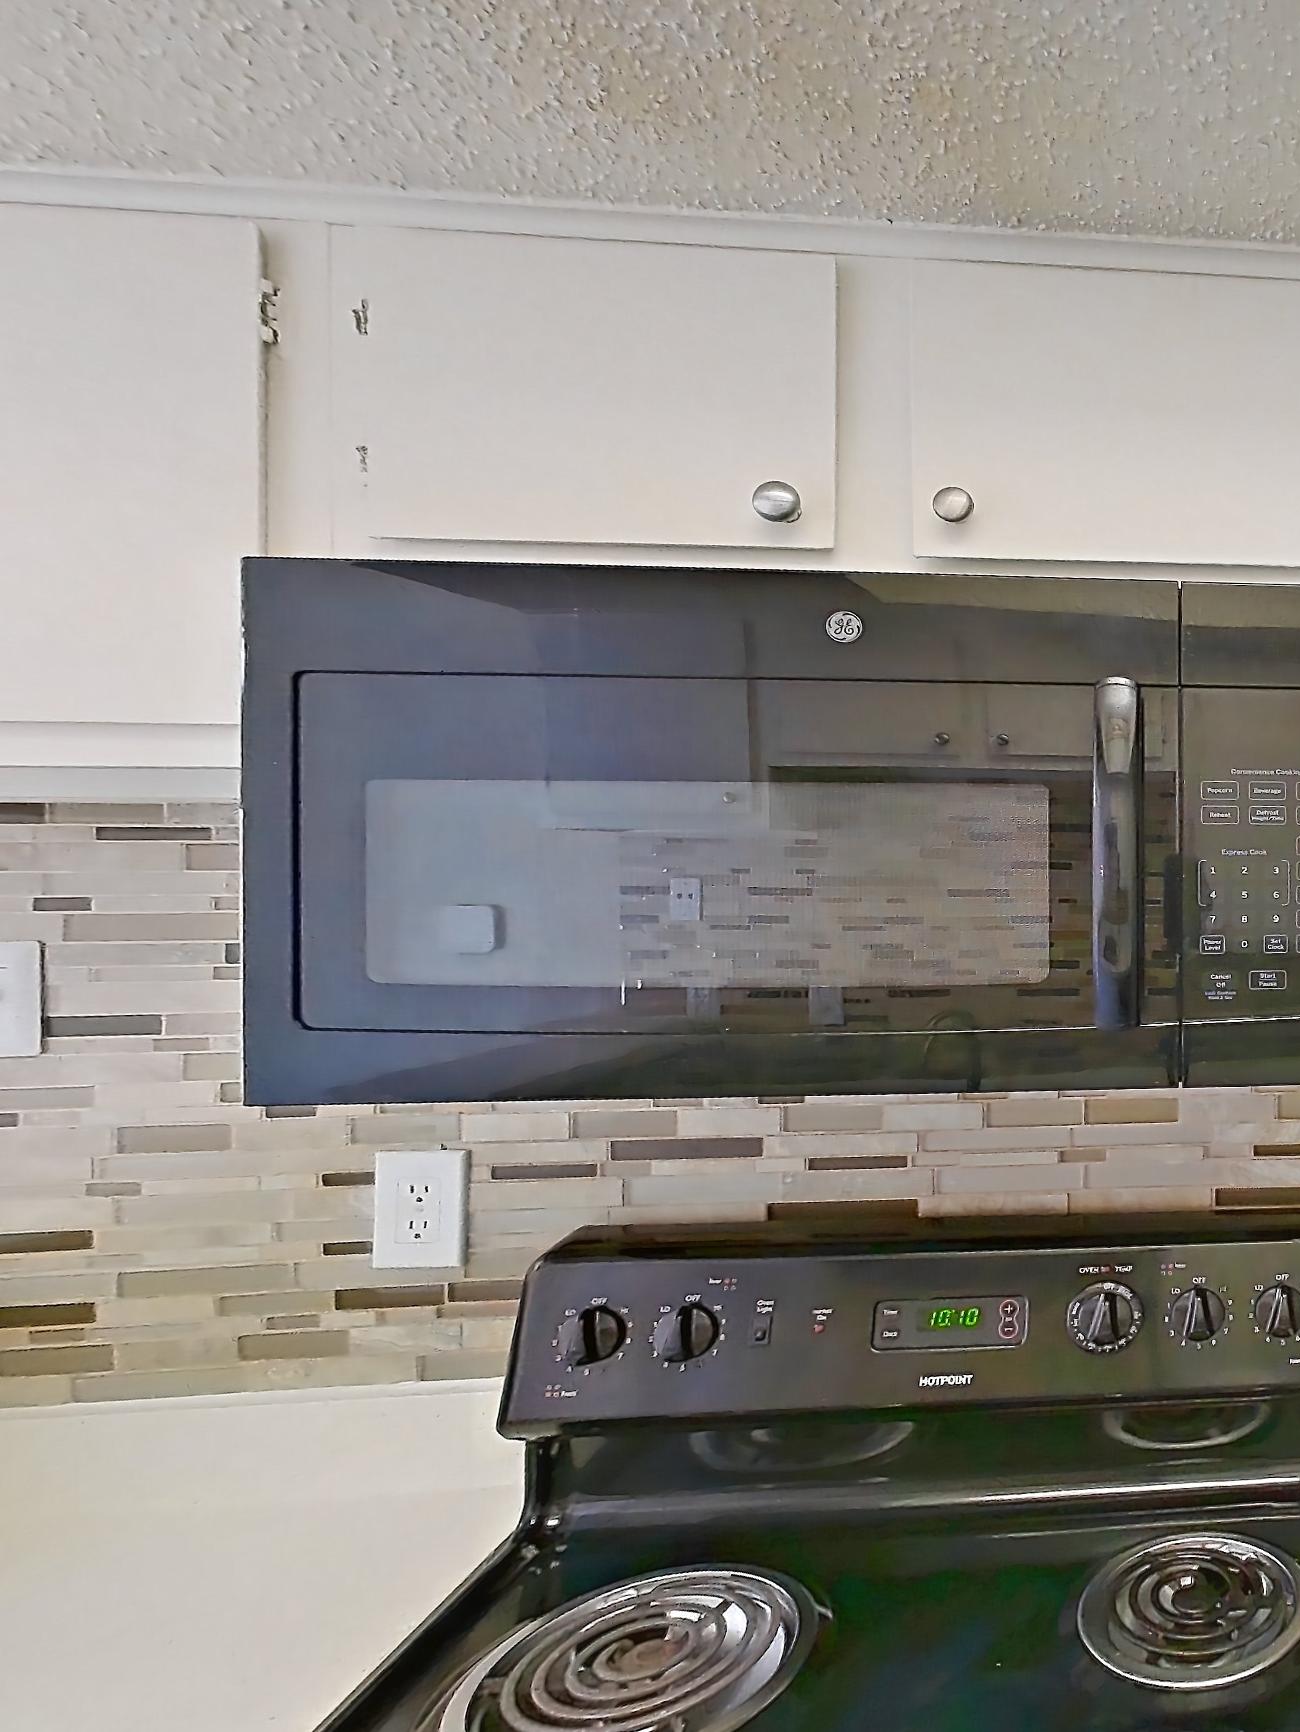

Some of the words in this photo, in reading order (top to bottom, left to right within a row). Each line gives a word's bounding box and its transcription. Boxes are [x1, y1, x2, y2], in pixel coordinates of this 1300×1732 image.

[1210, 866, 1216, 874] 1
[1241, 866, 1248, 874] 2
[1273, 866, 1279, 874] 3
[1210, 890, 1216, 898] 4
[1241, 890, 1248, 898] 5
[1273, 890, 1279, 898] 6
[1210, 915, 1216, 923] 7
[1241, 915, 1248, 923] 8
[1273, 915, 1279, 923] 9
[1241, 940, 1248, 948] 0
[1192, 1276, 1206, 1284] OFF
[930, 1307, 979, 1327] 10:10
[919, 1373, 974, 1386] HOTPOINT
